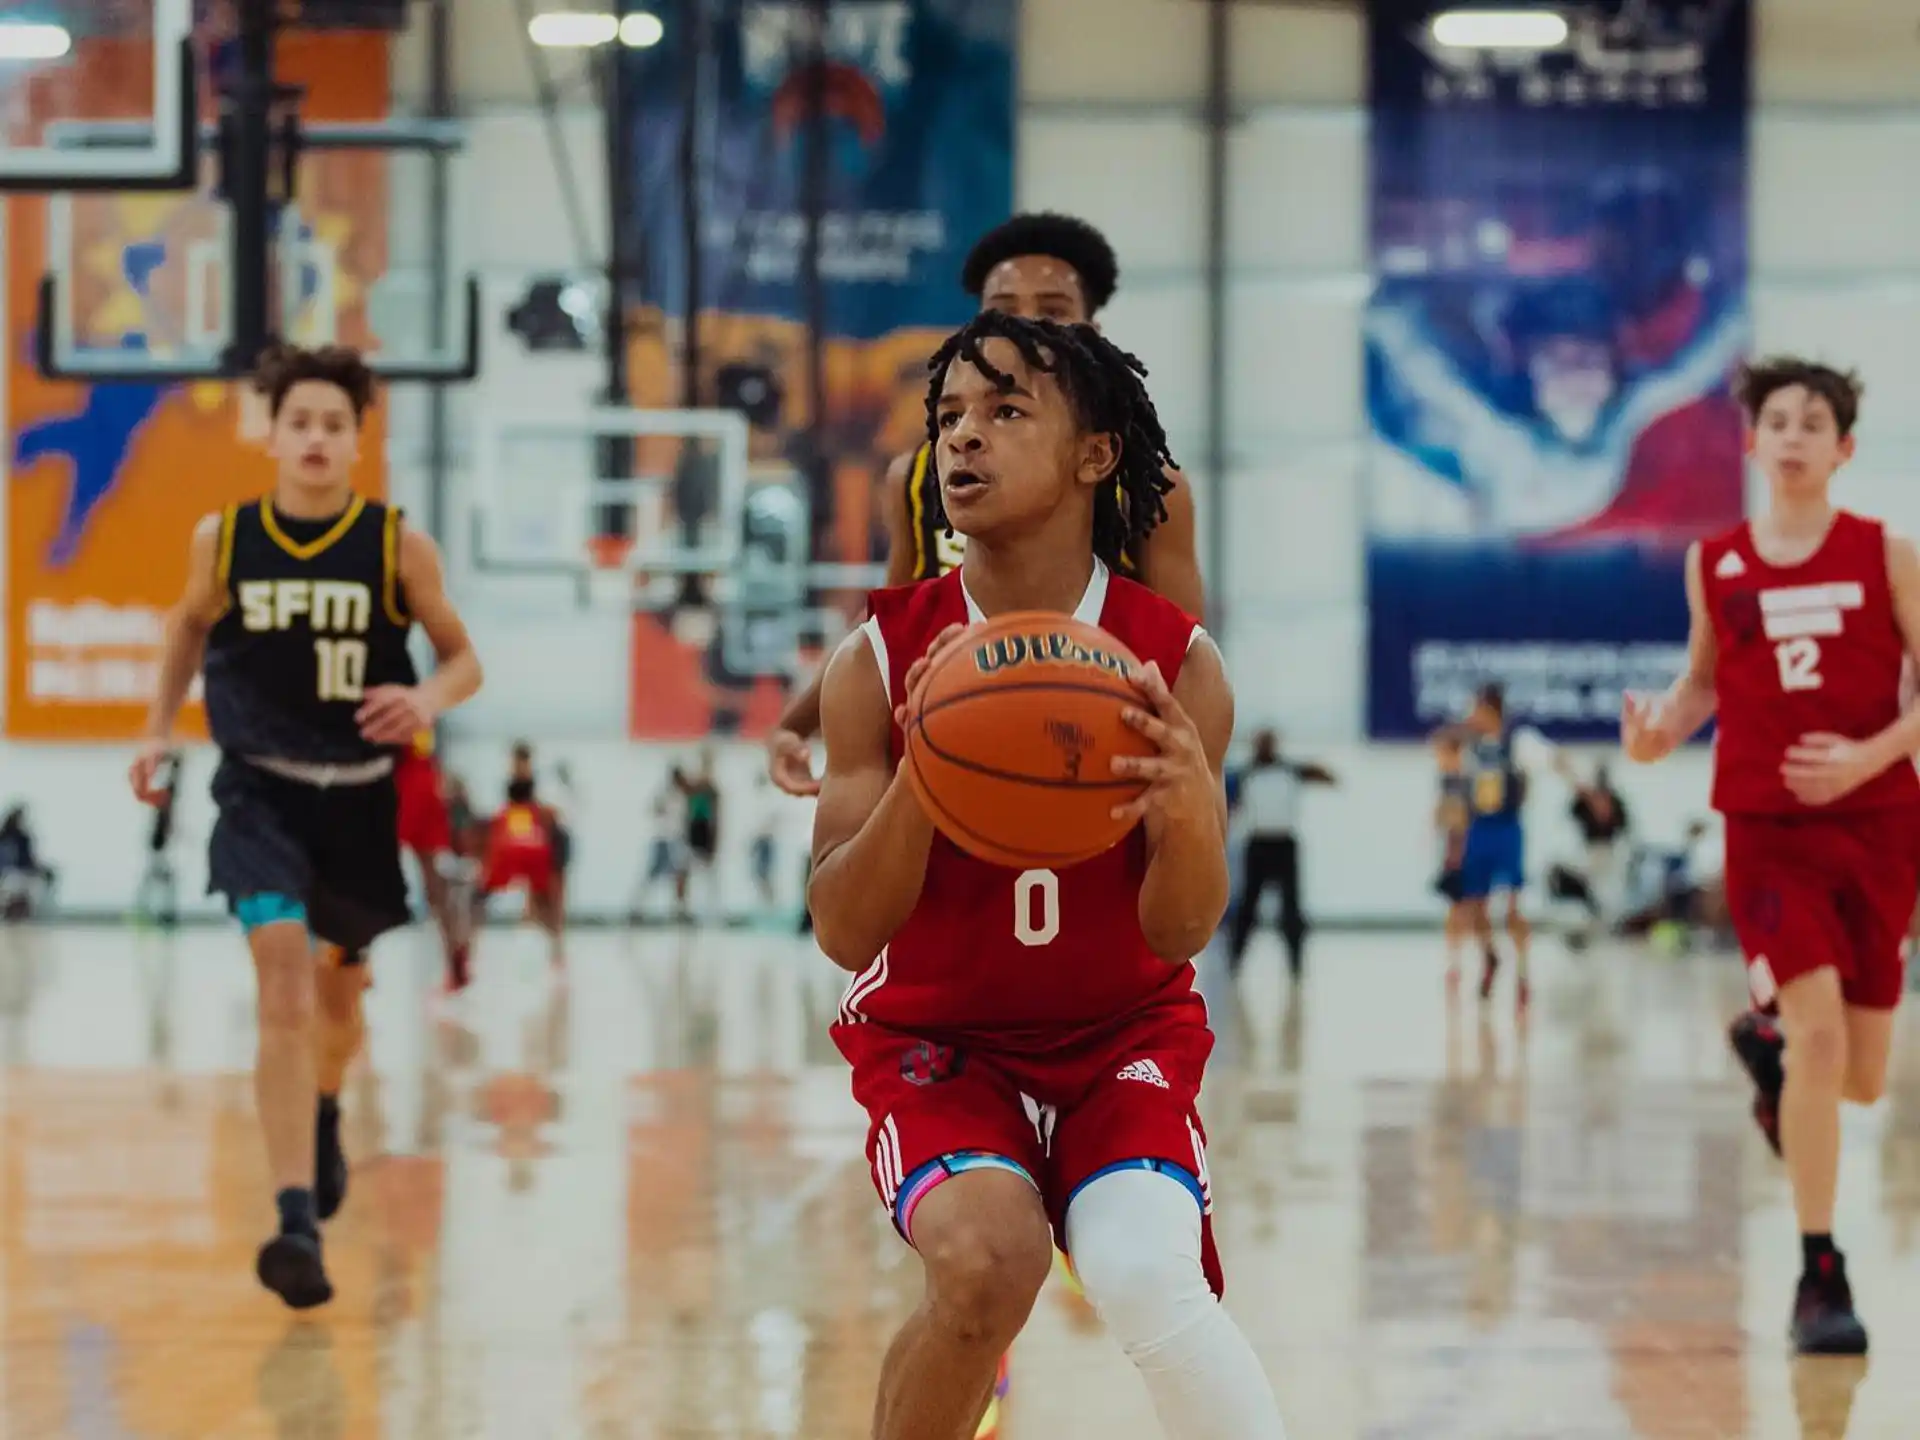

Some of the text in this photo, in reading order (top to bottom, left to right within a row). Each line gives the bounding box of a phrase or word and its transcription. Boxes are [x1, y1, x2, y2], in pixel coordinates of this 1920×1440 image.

[238, 579, 372, 634] SFM
[313, 636, 368, 702] 10
[1773, 637, 1824, 693] 12
[1014, 868, 1060, 946] 0
[1116, 1069, 1170, 1090] adidas
